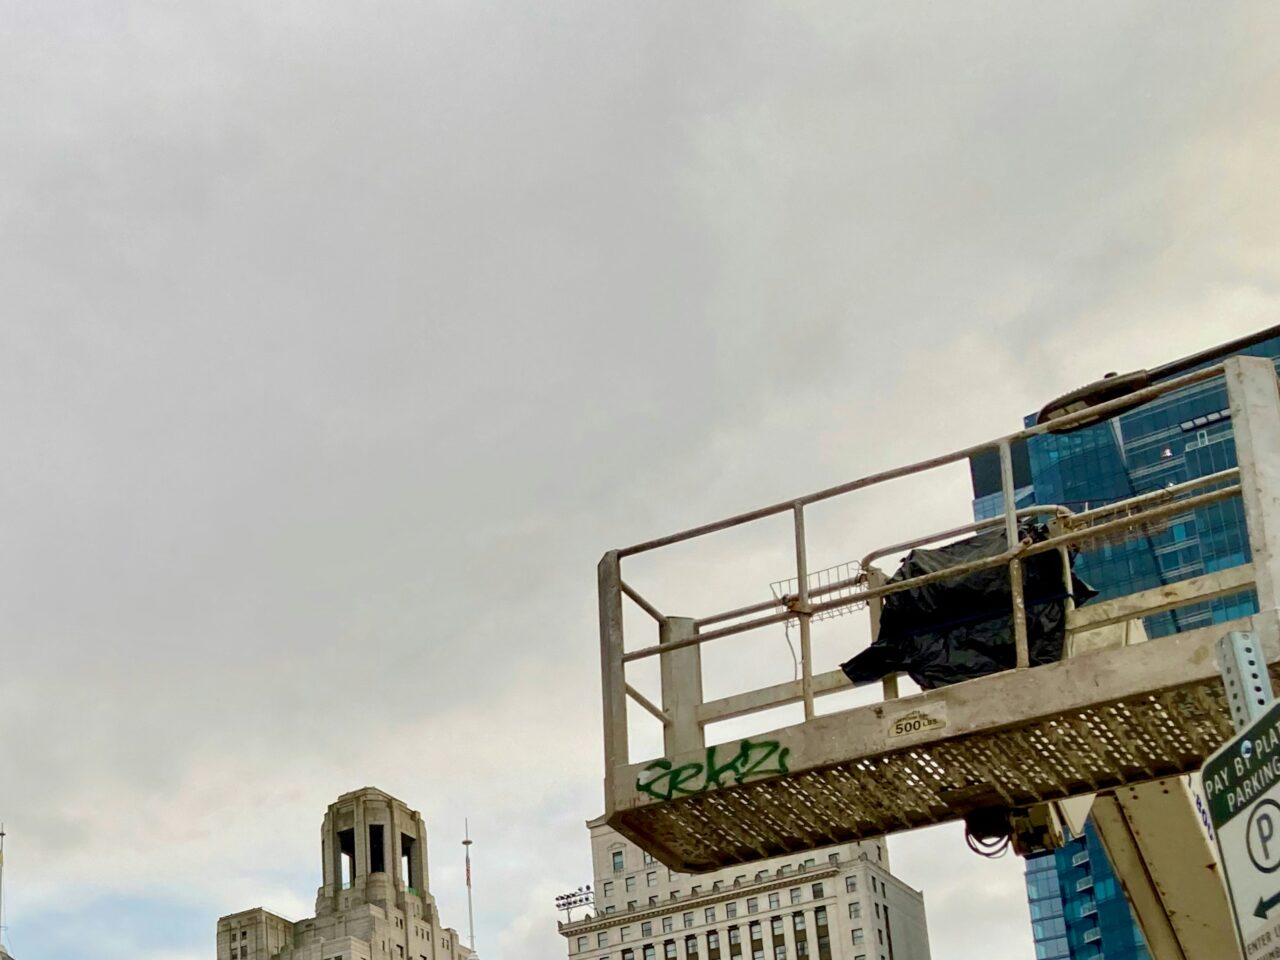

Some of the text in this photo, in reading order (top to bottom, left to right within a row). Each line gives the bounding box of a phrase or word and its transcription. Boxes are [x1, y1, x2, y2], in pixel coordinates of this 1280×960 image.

[896, 720, 921, 734] 500
[1205, 767, 1229, 800] PAY
[1234, 756, 1251, 777] BY
[1227, 755, 1280, 812] PARKING
[1256, 812, 1274, 860] P
[1247, 930, 1272, 955] ENTER
